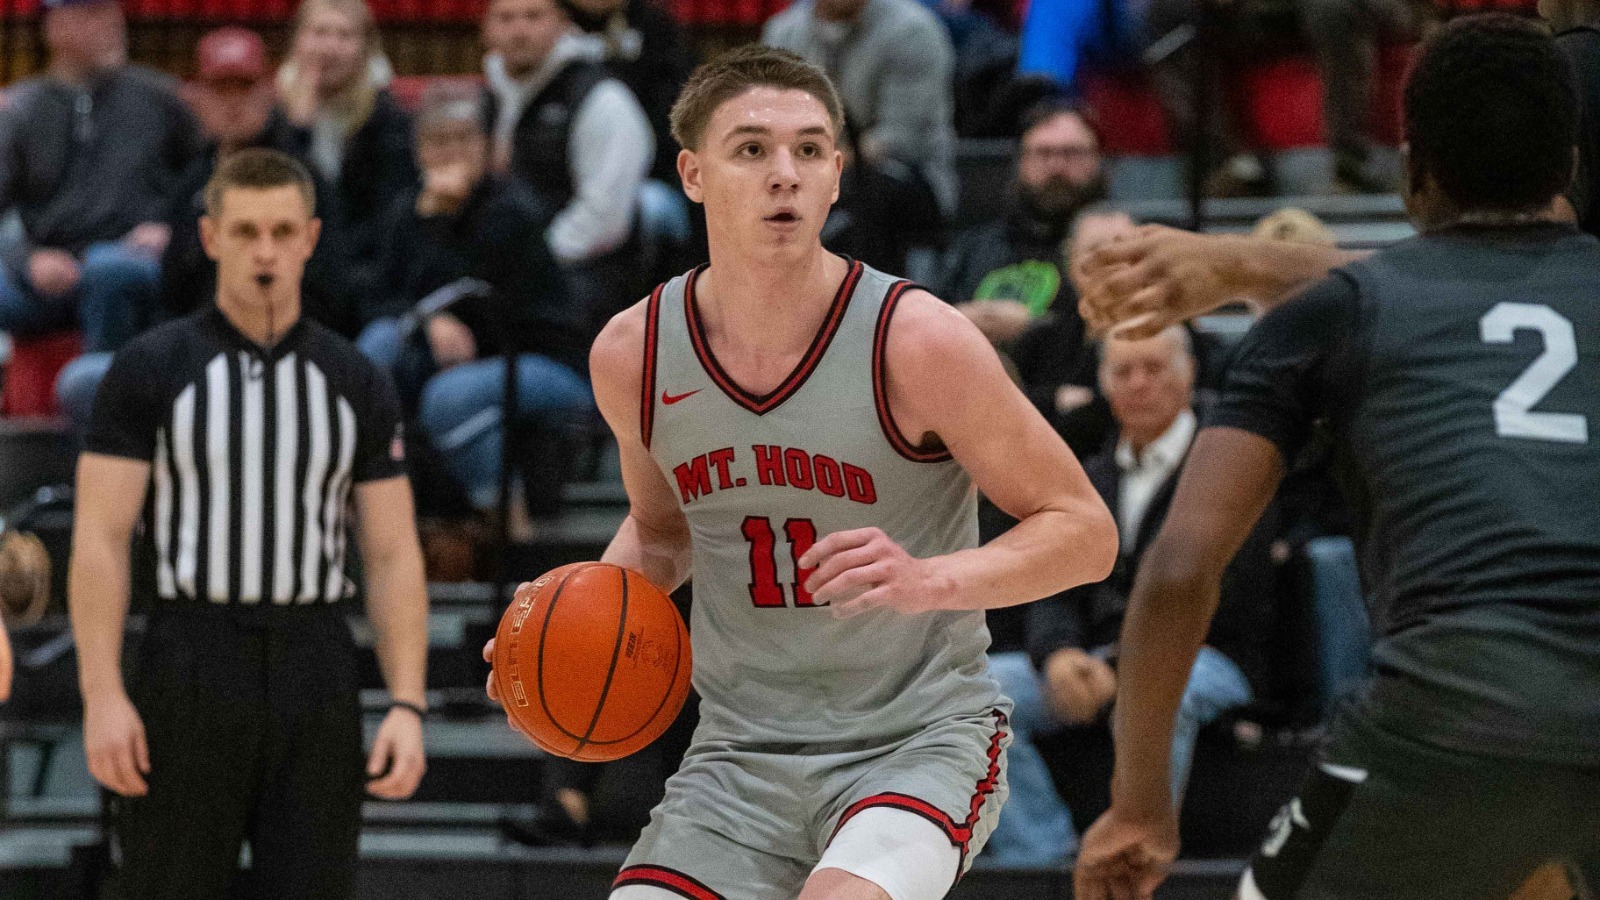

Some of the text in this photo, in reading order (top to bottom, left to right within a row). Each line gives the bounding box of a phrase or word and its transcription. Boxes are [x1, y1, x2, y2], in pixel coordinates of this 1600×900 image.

[1479, 302, 1588, 444] 2
[673, 444, 877, 505] MT. HOOD
[741, 515, 830, 608] 11
